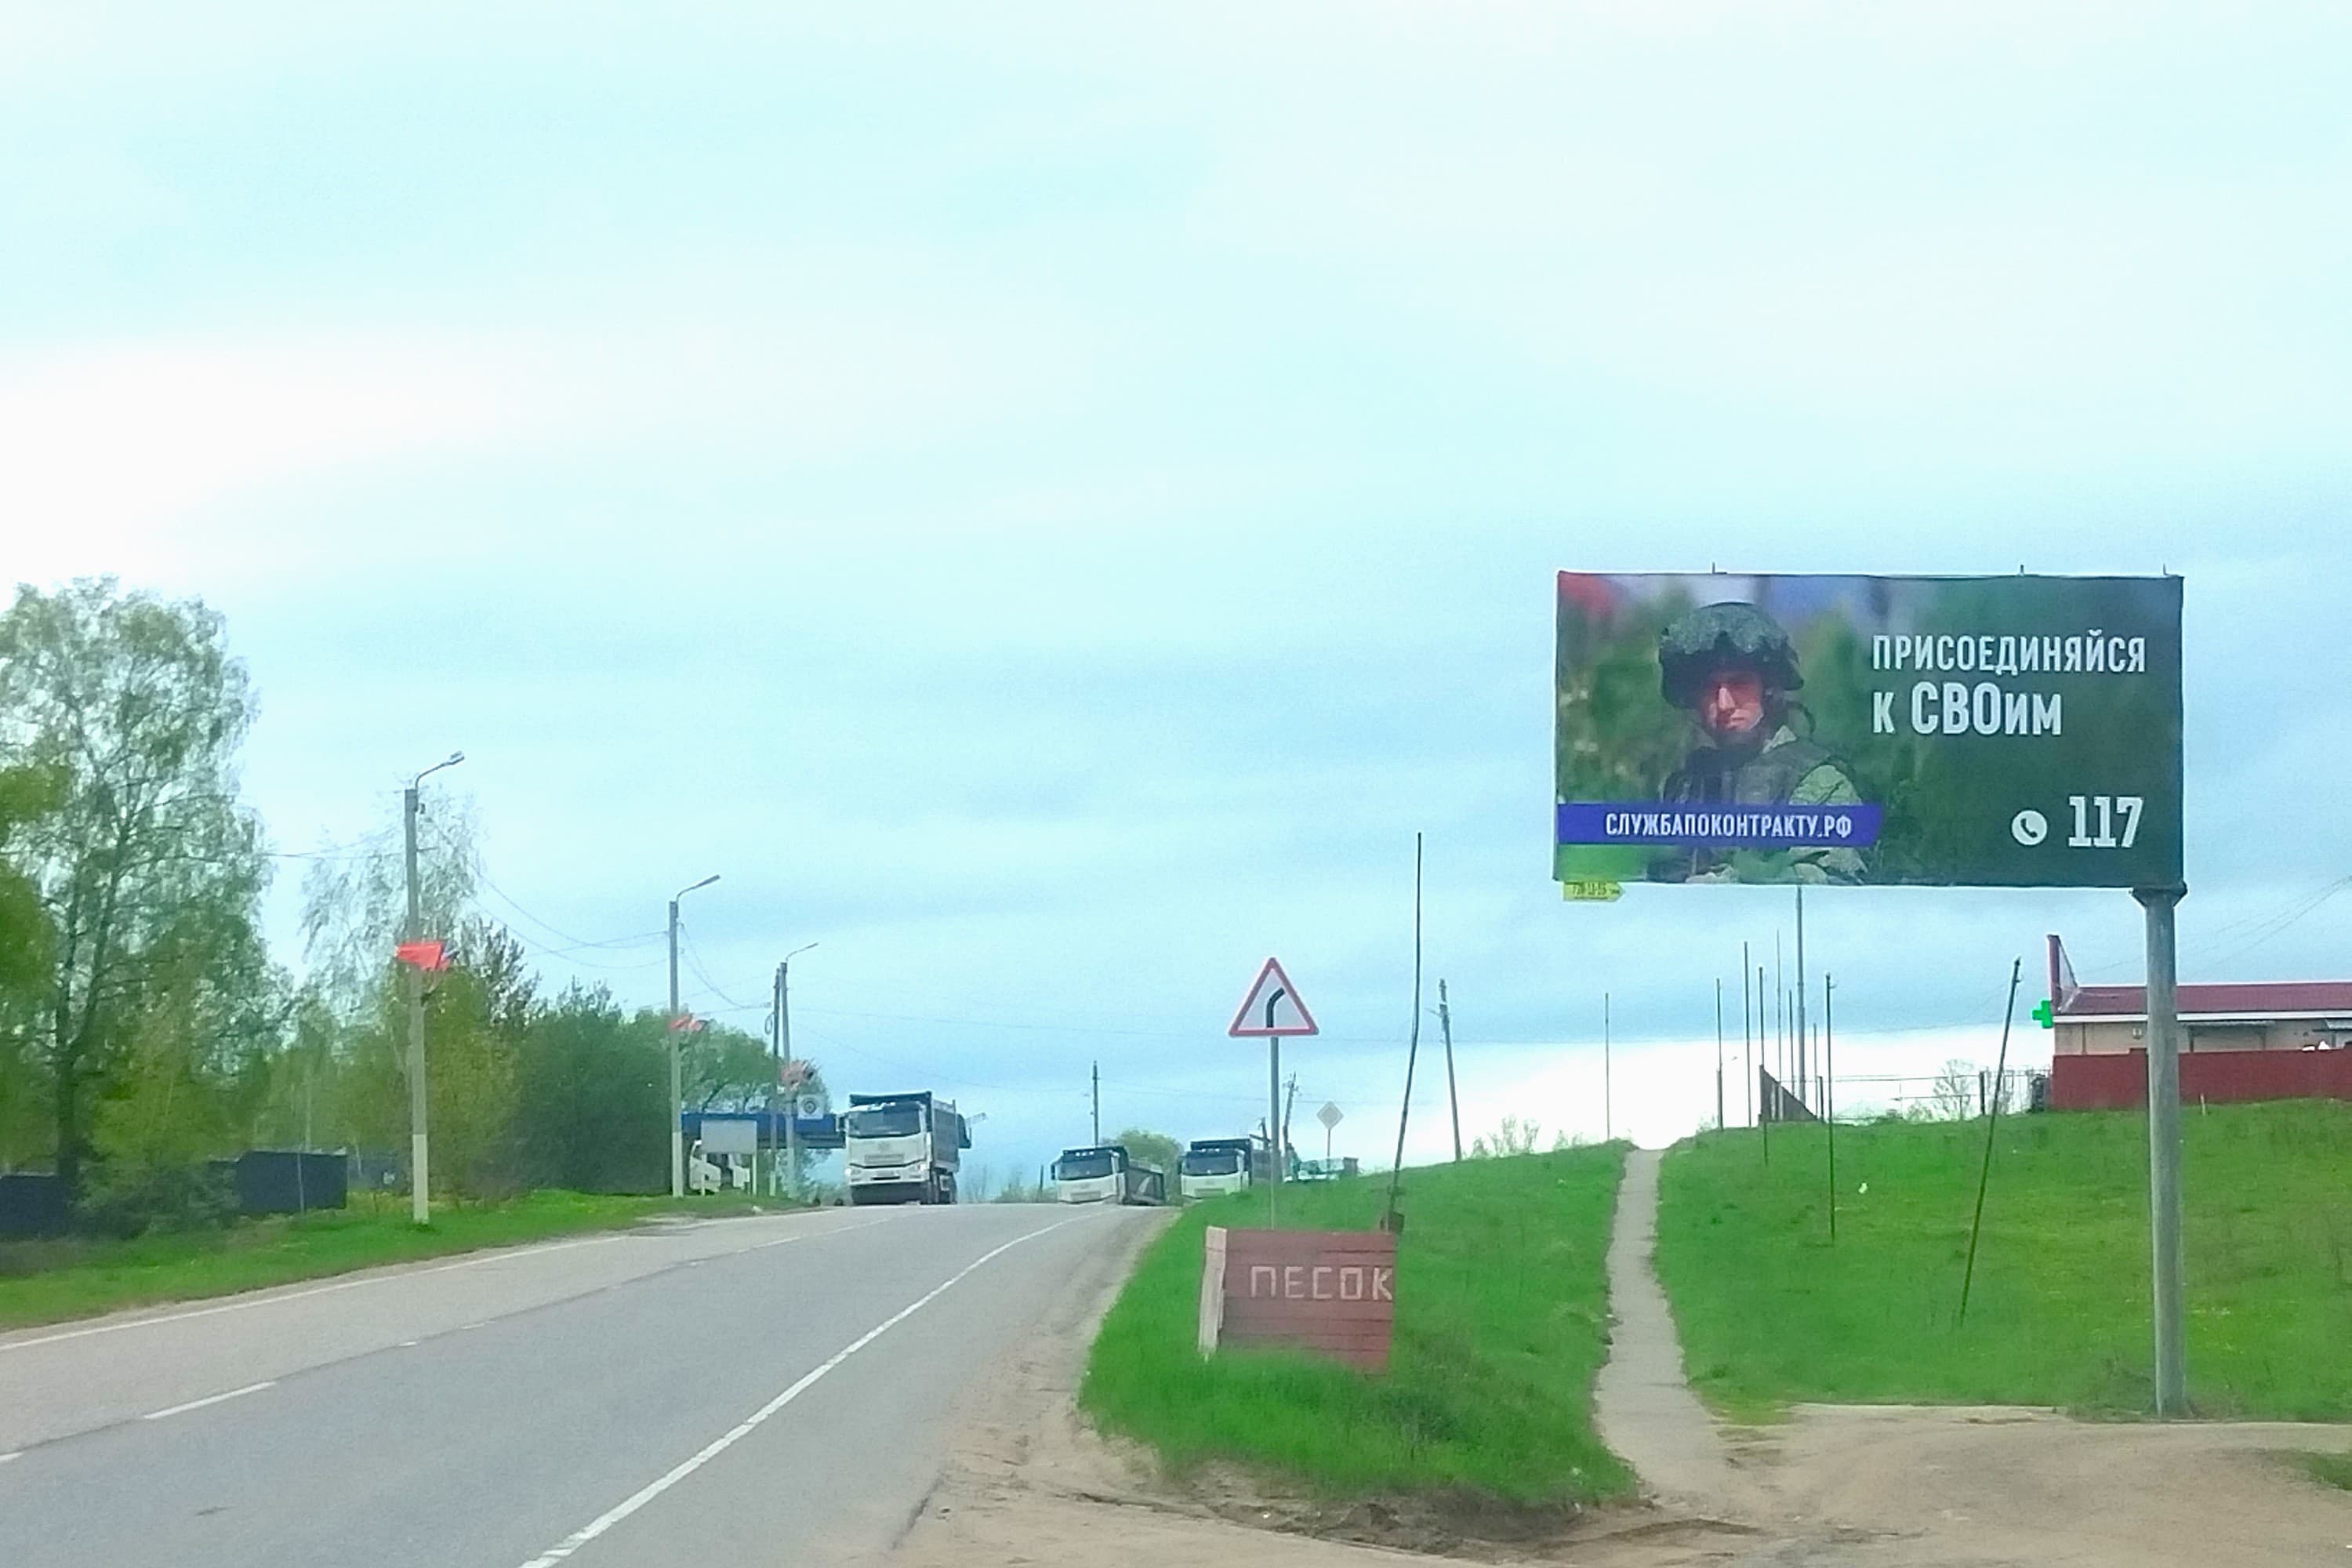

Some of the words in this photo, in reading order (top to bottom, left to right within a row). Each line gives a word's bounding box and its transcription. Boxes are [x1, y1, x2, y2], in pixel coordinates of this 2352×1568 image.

[1872, 629, 2146, 676] ПРИСОЕДИНЯЙСЯ
[1606, 812, 1852, 839] СЛУЖБАПОКОНТРАКТУ.РФ
[2068, 796, 2143, 848] 117
[1250, 1266, 1393, 1301] ПЕСОК
